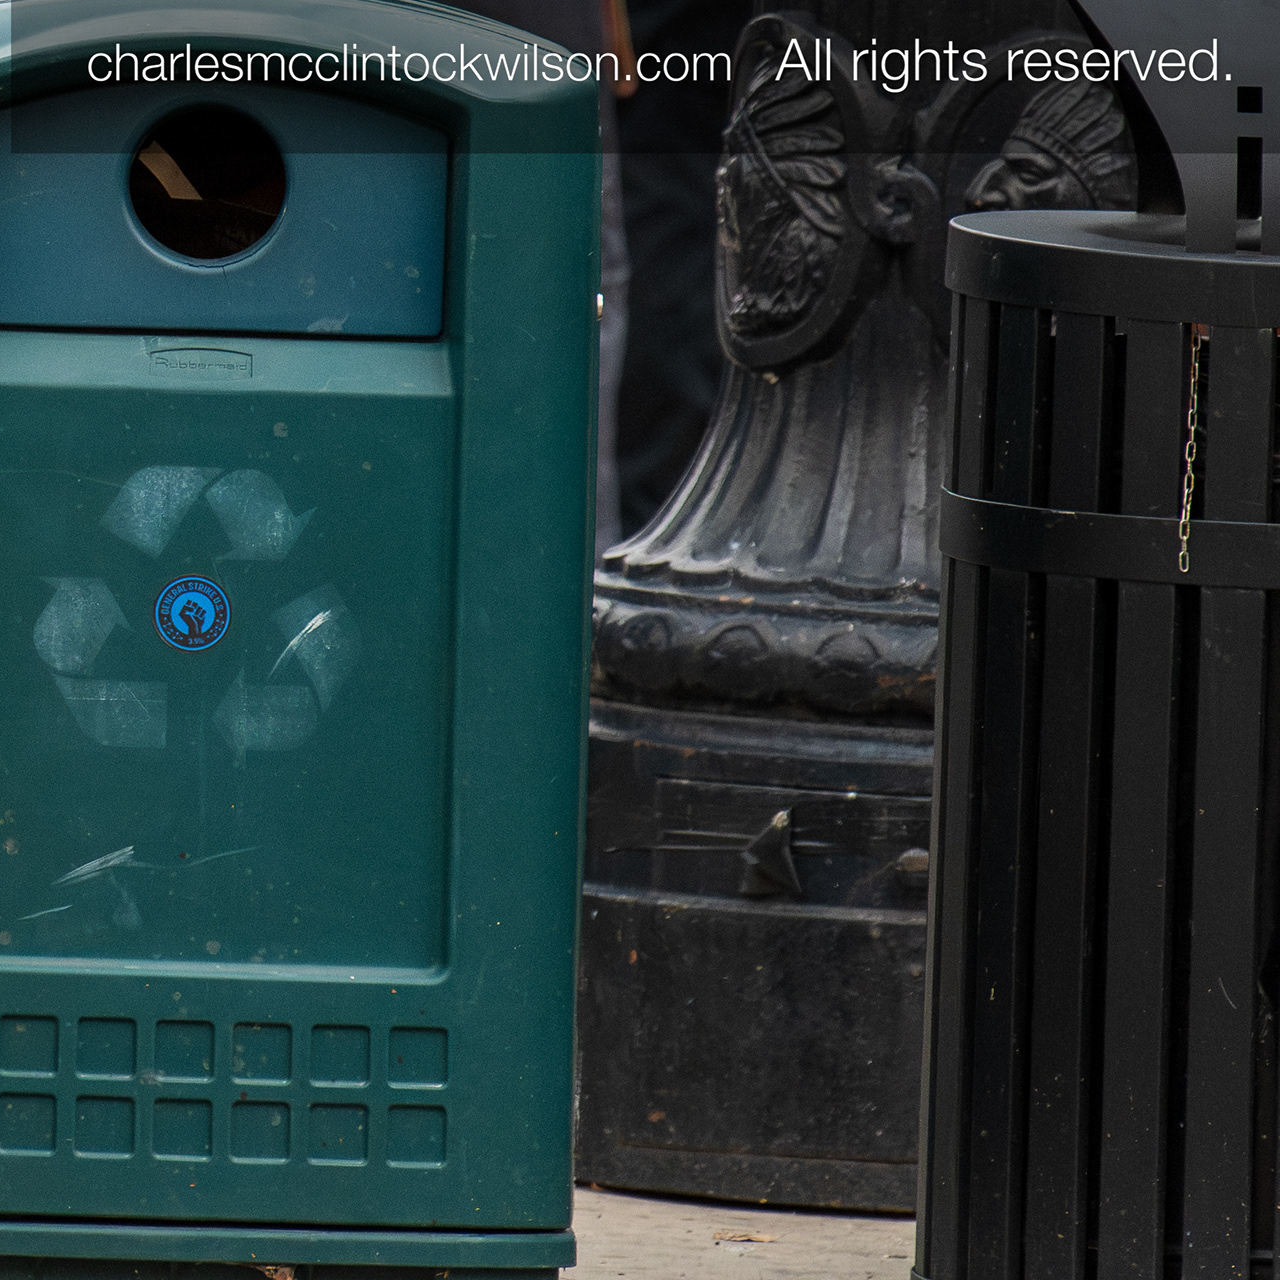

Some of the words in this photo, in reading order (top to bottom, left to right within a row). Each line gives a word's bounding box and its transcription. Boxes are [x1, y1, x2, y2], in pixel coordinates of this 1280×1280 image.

[154, 356, 249, 372] Rubbermaid
[160, 583, 188, 615] GENERAL
[188, 581, 218, 600] STRIKE
